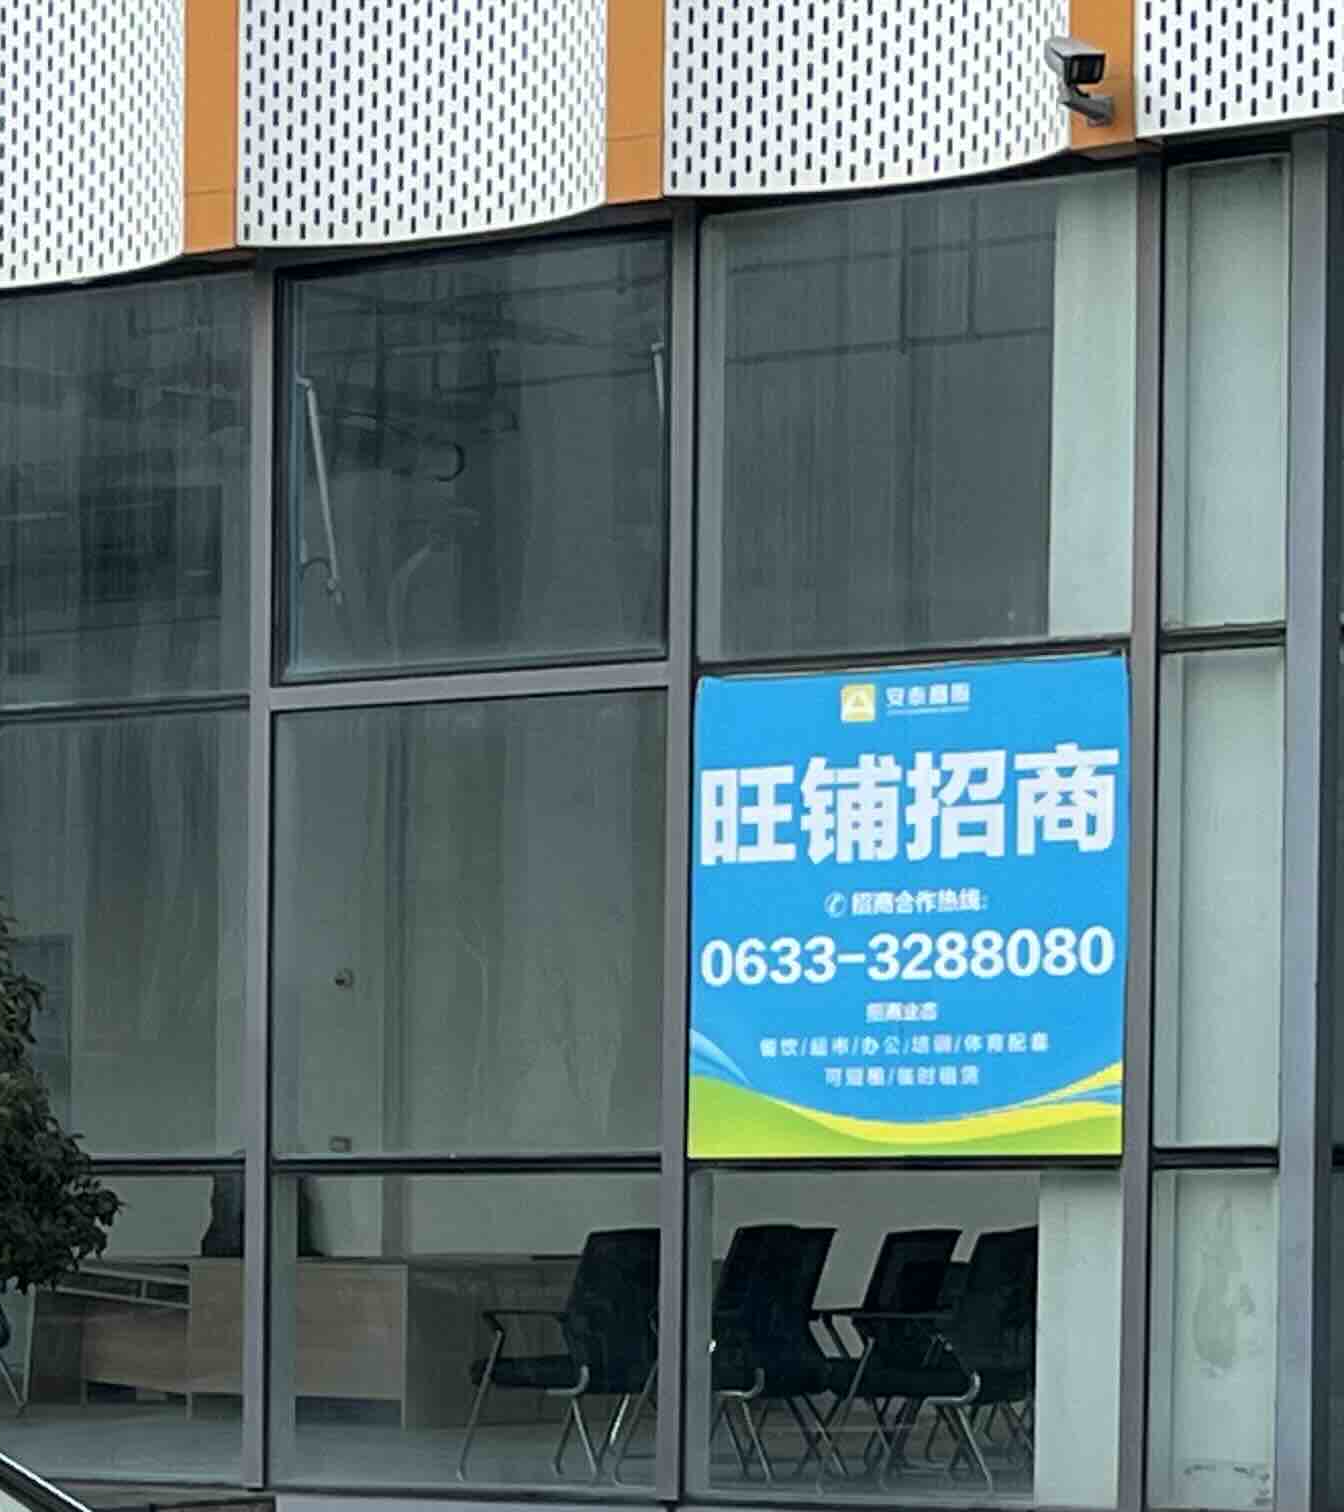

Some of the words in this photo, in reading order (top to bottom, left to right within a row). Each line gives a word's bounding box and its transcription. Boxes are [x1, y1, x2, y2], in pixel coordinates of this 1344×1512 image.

[699, 742, 1119, 866] 旺铺招商
[701, 926, 1115, 987] 0633-3288080
